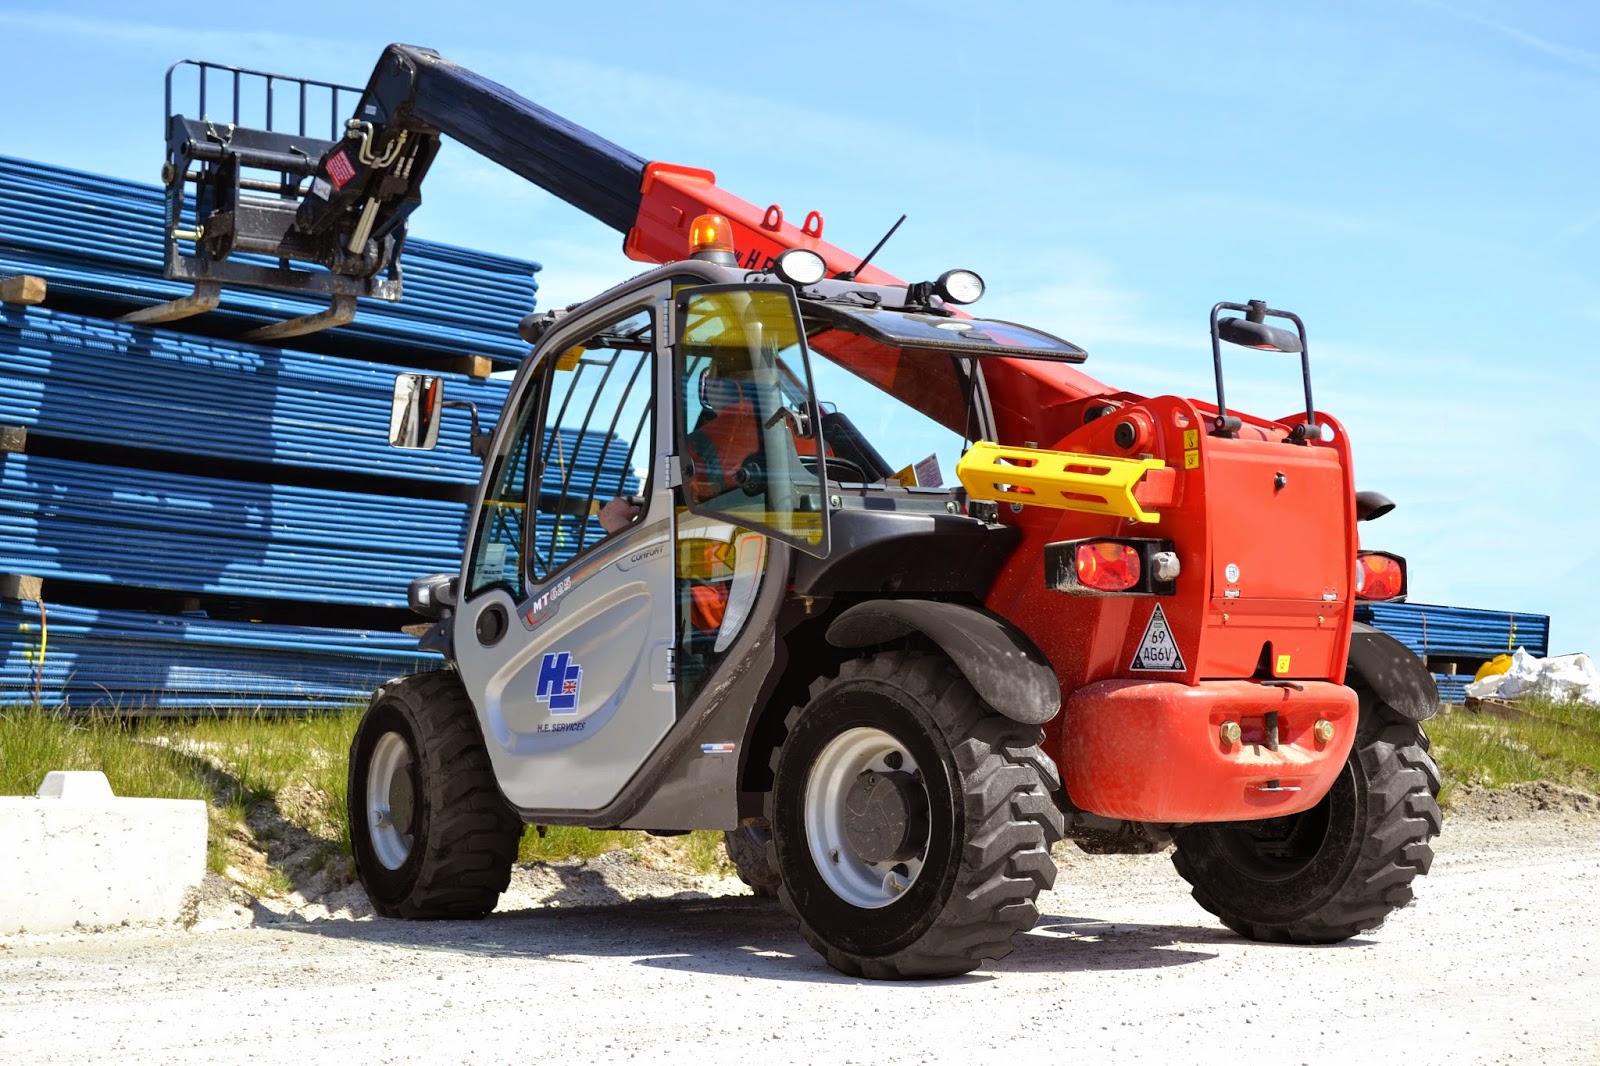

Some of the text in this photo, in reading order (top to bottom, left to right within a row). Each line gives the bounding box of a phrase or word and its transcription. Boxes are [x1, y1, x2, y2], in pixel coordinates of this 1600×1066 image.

[533, 592, 549, 614] MT
[1152, 630, 1165, 644] 69
[1143, 647, 1172, 662] AG6V
[537, 722, 586, 733] H.E. SERVICES
